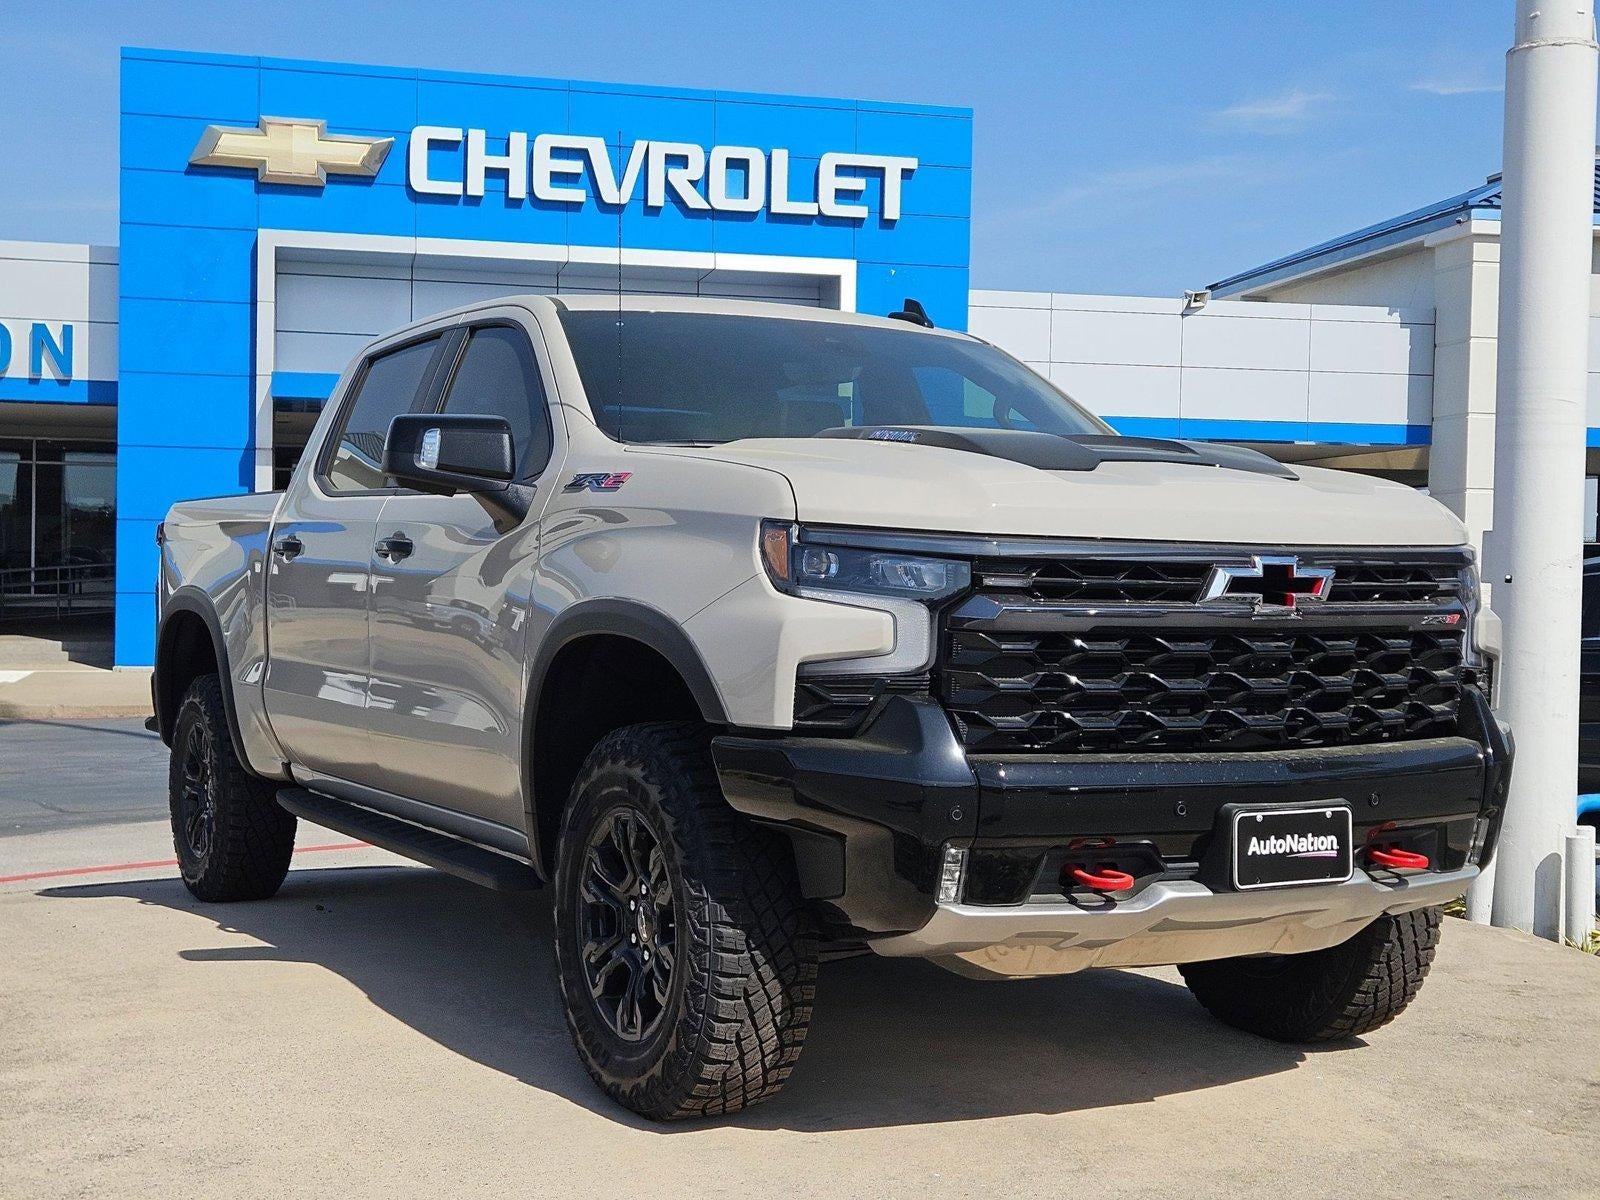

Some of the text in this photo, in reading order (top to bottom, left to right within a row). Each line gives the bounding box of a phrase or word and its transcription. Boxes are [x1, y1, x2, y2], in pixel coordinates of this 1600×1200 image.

[408, 125, 918, 220] CHEVROLET
[0, 322, 73, 377] N
[562, 473, 633, 492] ZR2
[1247, 833, 1339, 856] AutoNation
